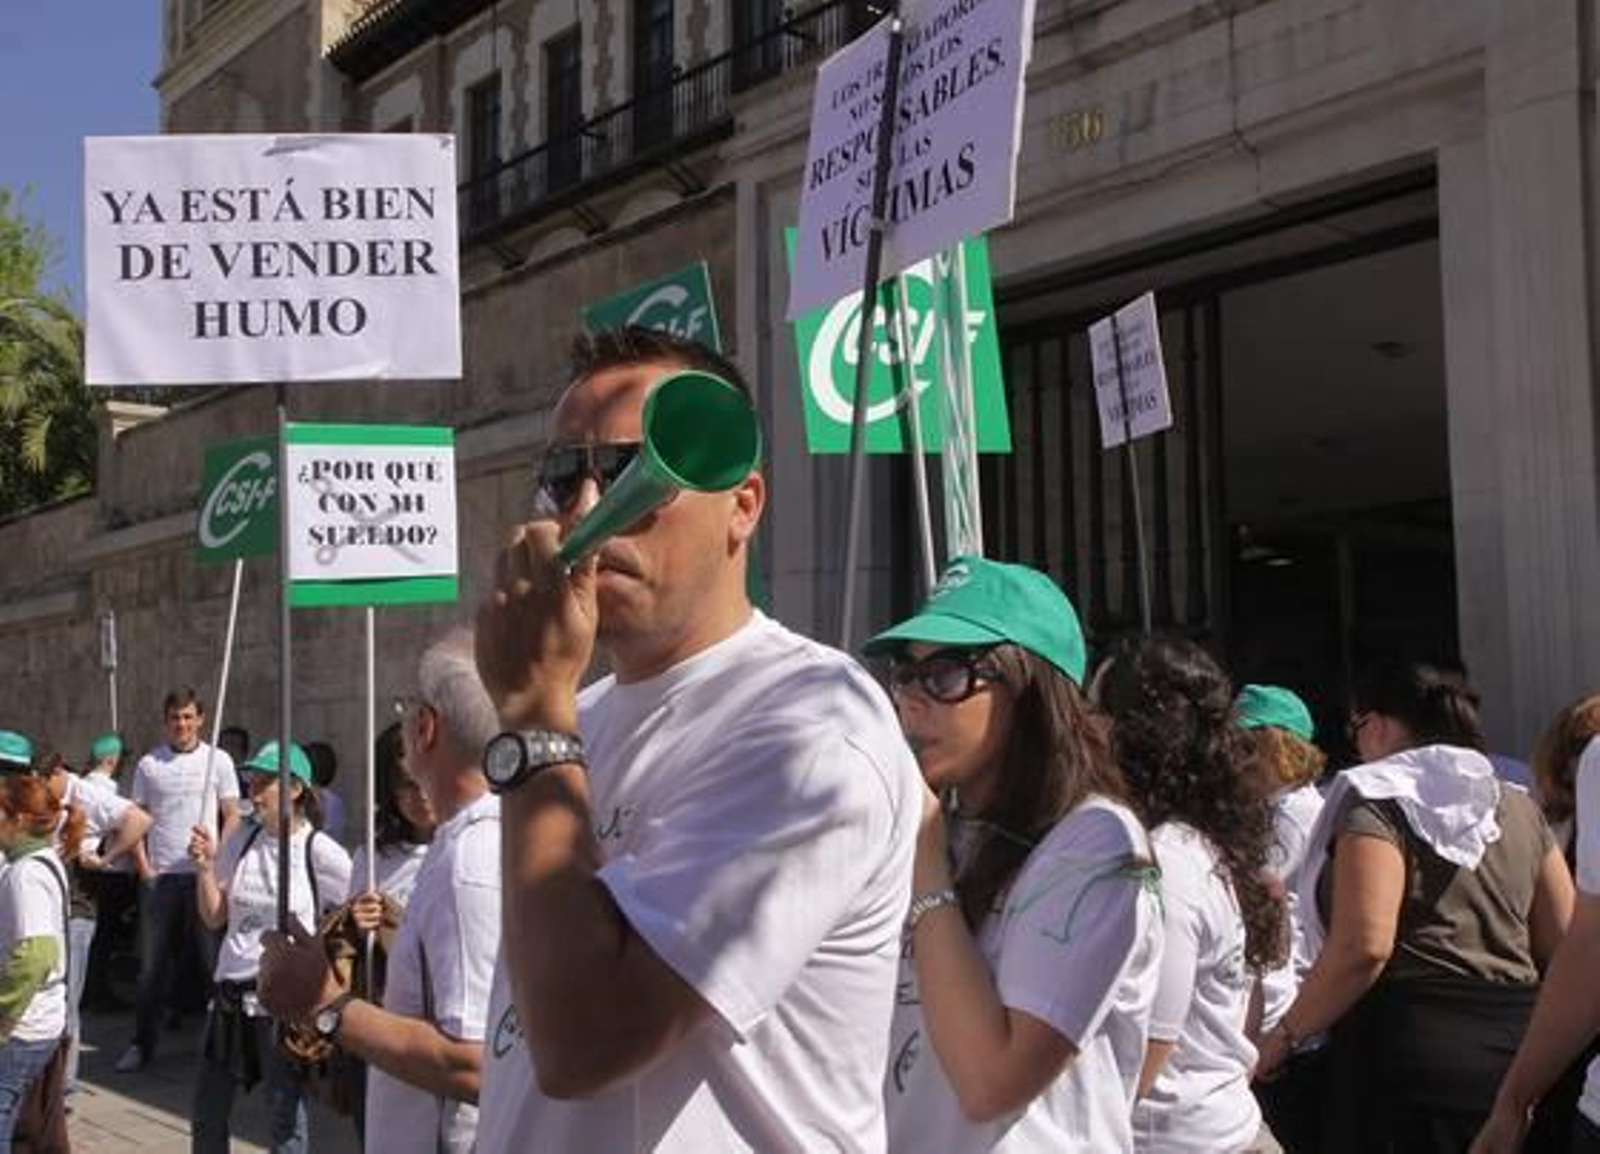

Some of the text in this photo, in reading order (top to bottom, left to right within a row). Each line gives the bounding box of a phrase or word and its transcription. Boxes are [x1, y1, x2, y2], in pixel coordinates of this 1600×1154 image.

[102, 178, 435, 224] YA ESTÁ BIEN
[821, 141, 976, 262] VÍCIMAS
[119, 239, 437, 281] DE VENDER
[192, 298, 367, 339] HUMO
[298, 455, 442, 486] ¿POR QUÉ
[318, 493, 426, 513] CON MI
[308, 525, 438, 547] SUELDO?
